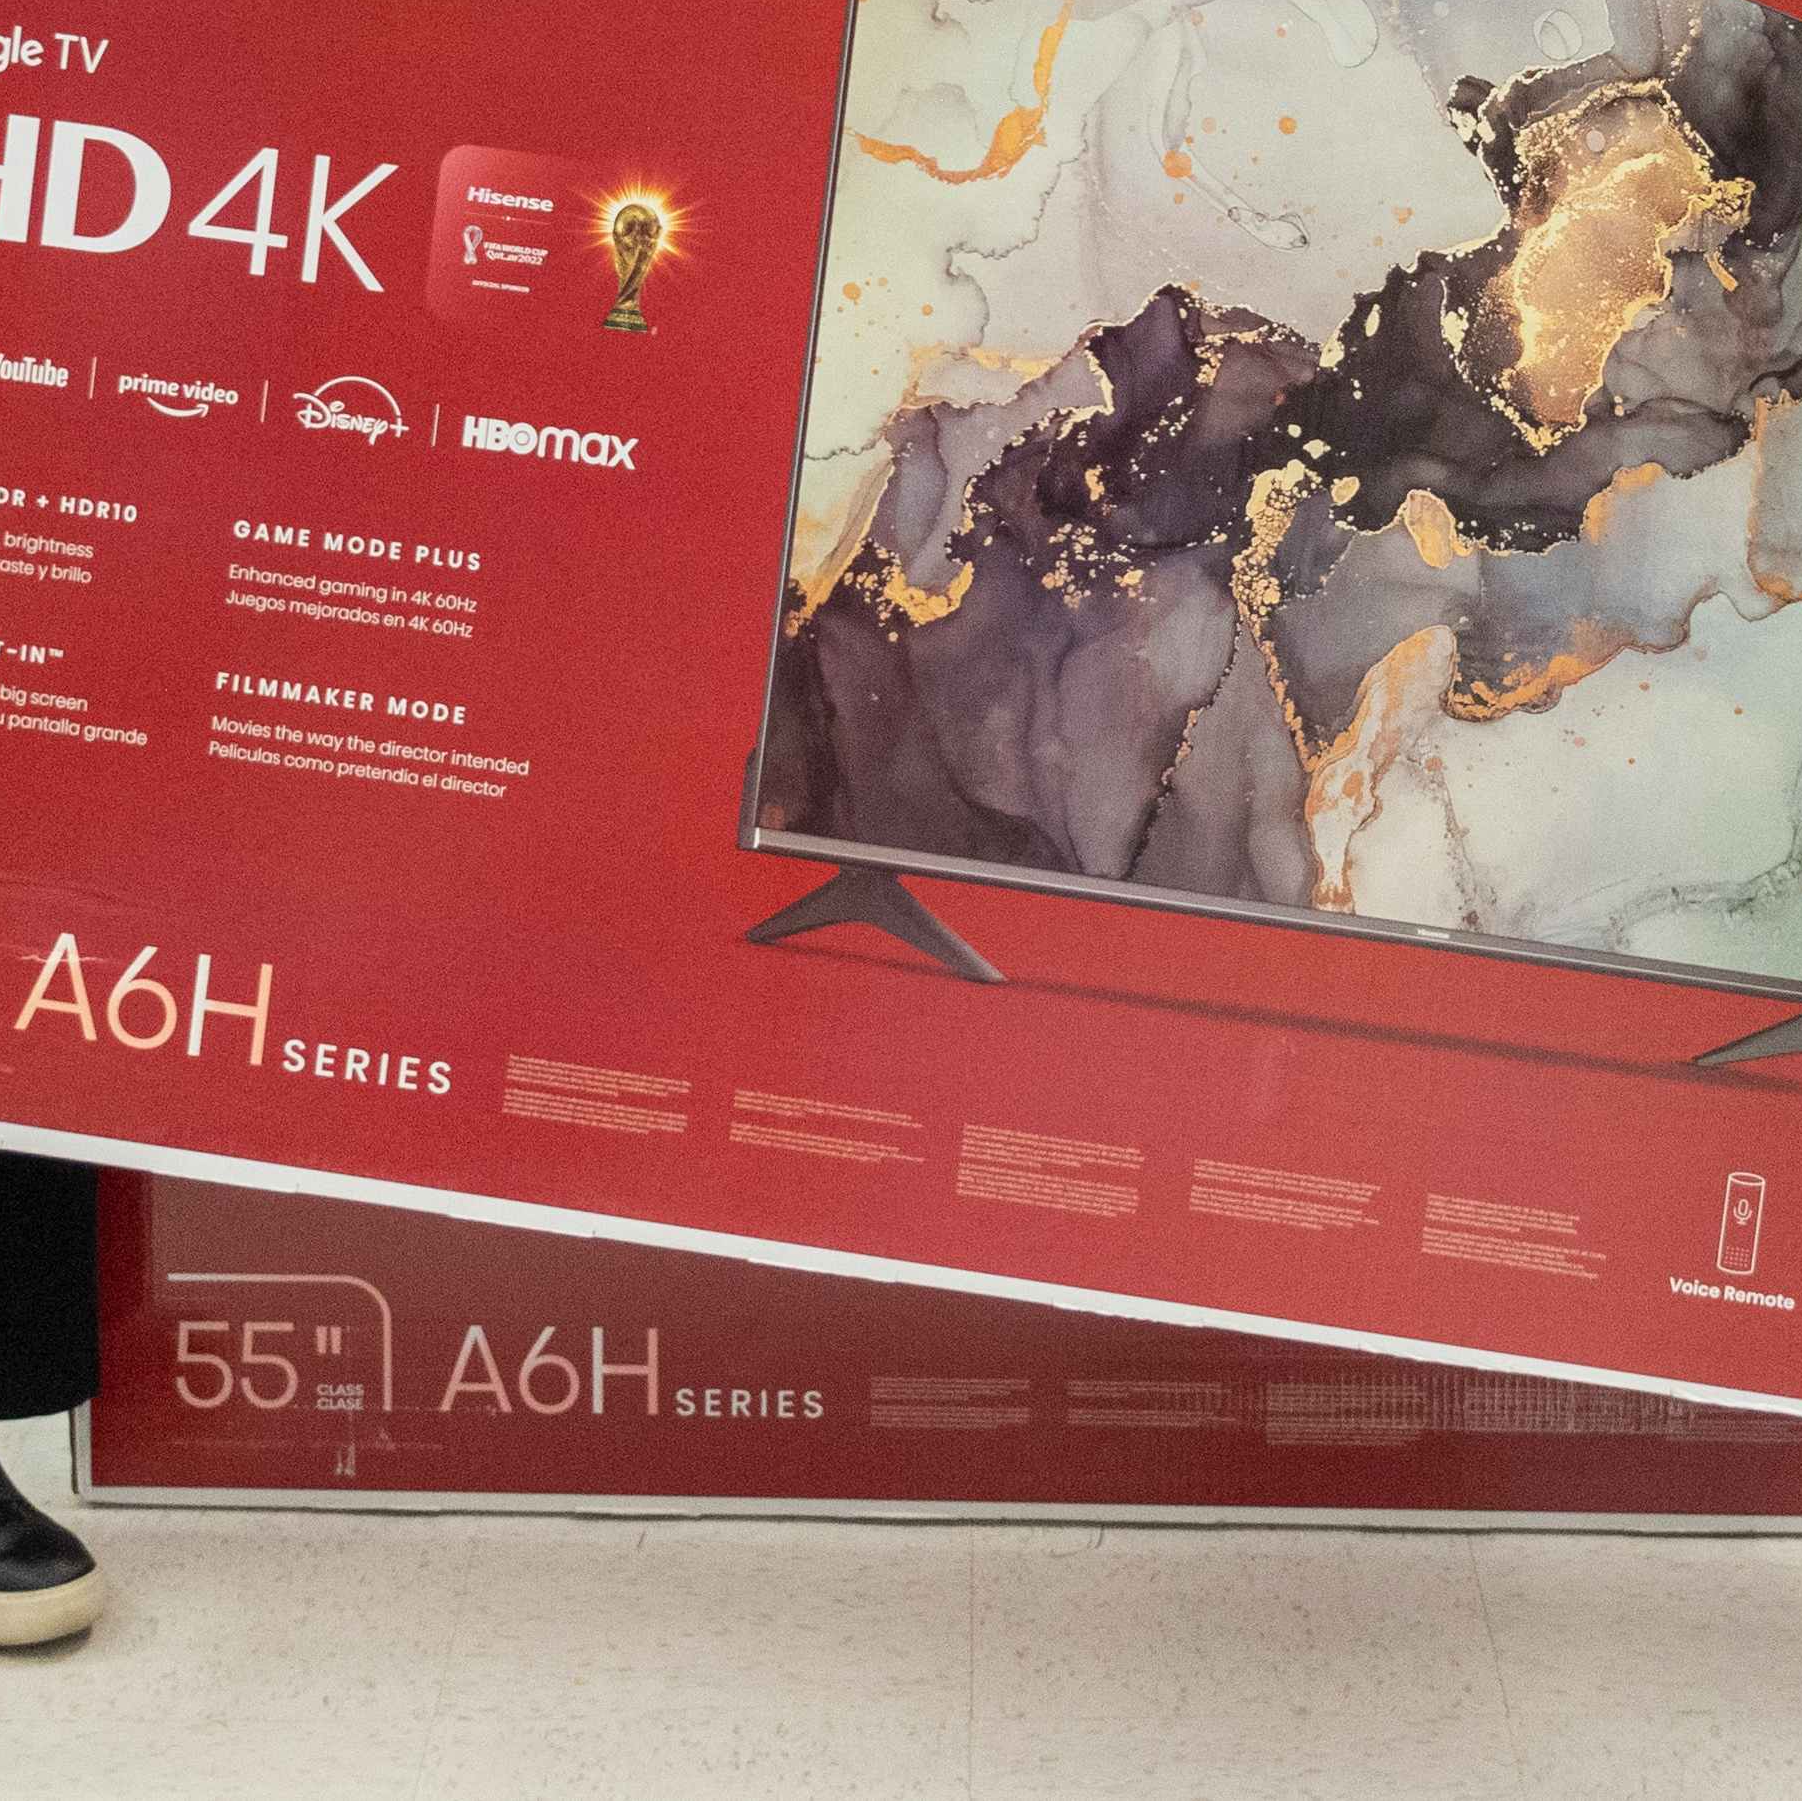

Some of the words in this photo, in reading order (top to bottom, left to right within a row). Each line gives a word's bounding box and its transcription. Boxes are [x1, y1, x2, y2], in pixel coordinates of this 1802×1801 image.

[53, 29, 110, 76] TV
[187, 146, 401, 295] 4K
[466, 185, 556, 213] Hisense
[501, 243, 530, 254] WORLD
[118, 372, 180, 401] prime
[182, 380, 240, 406] video
[292, 379, 410, 446] Disney+
[36, 494, 51, 510] +
[59, 495, 139, 525] HDR10
[4, 529, 96, 561] brightness
[232, 519, 312, 549] GAME
[324, 531, 403, 561] MODE
[414, 544, 483, 571] PLUS
[37, 562, 49, 581] y
[51, 561, 94, 585] brillo
[228, 564, 317, 592] Enhanced
[318, 575, 389, 605] gaming
[390, 585, 408, 603] in
[410, 588, 435, 609] 4K
[435, 591, 478, 614] 60Hz
[225, 589, 287, 614] Juegos
[288, 594, 381, 626] mejorados
[383, 610, 406, 628] en
[407, 613, 431, 634] 4K
[432, 617, 475, 640] 60Hz
[29, 689, 89, 713] screen
[214, 670, 376, 712] FILMMAKER
[386, 695, 468, 726] MODE
[7, 711, 81, 737] pantalla
[82, 720, 149, 747] grande
[210, 714, 272, 740] Movies
[273, 722, 304, 744] the
[305, 730, 344, 753] way
[346, 732, 377, 754] the
[378, 737, 449, 765] director
[449, 747, 531, 777] intended
[283, 753, 335, 774] como
[421, 772, 438, 789] el
[439, 773, 508, 799] director
[14, 931, 275, 1067] A6H
[282, 1037, 455, 1095] SERIES
[1668, 1276, 1721, 1300] Voice
[1722, 1285, 1797, 1313] Remote
[175, 1320, 344, 1411] 55"
[439, 1324, 660, 1416] A6H
[676, 1387, 827, 1420] SERIES
[315, 1383, 366, 1398] CLASS
[315, 1397, 366, 1412] CLASE
